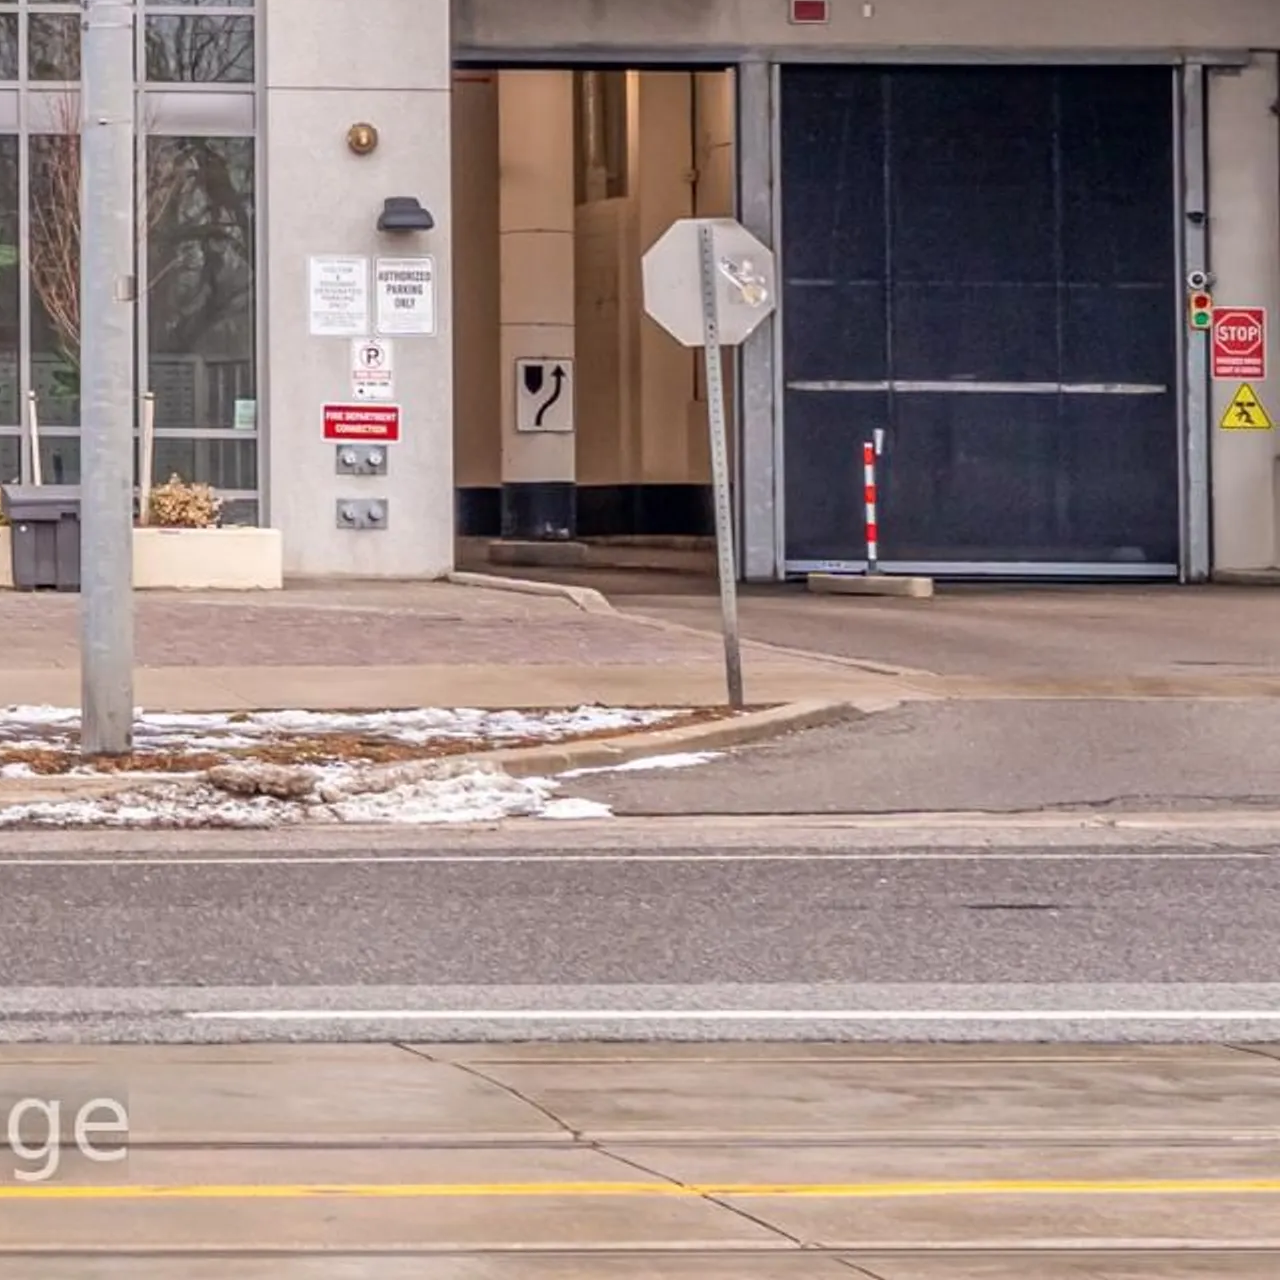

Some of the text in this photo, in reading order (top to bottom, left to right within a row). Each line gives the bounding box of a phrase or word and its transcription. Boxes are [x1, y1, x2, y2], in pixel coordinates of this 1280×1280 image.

[386, 283, 424, 295] PARKING
[394, 297, 416, 309] ONLY
[1218, 326, 1258, 341] STOP
